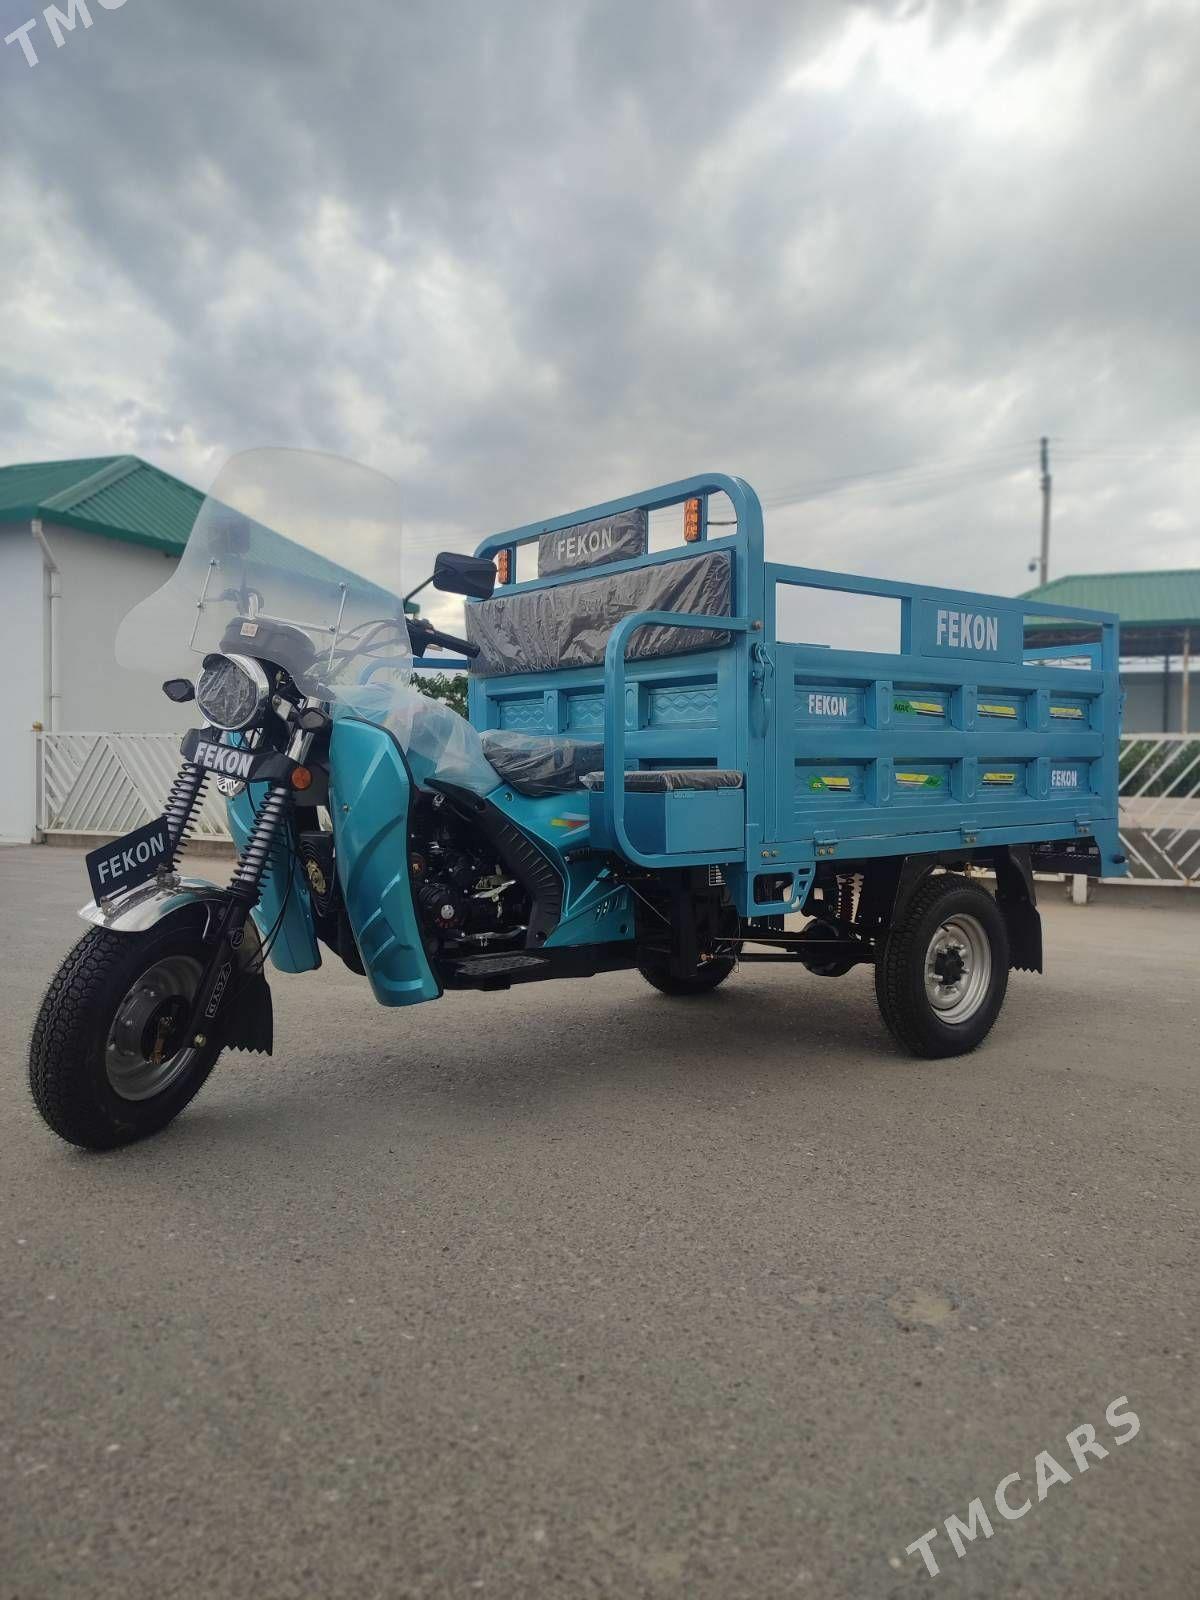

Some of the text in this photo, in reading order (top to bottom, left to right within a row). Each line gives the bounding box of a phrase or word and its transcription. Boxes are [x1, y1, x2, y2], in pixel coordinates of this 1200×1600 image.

[556, 526, 612, 561] FEKON
[937, 609, 998, 651] FEKON
[808, 694, 848, 717] FEKON
[193, 741, 254, 778] FEKON
[1051, 769, 1078, 787] FEKON
[97, 832, 165, 884] FEKON
